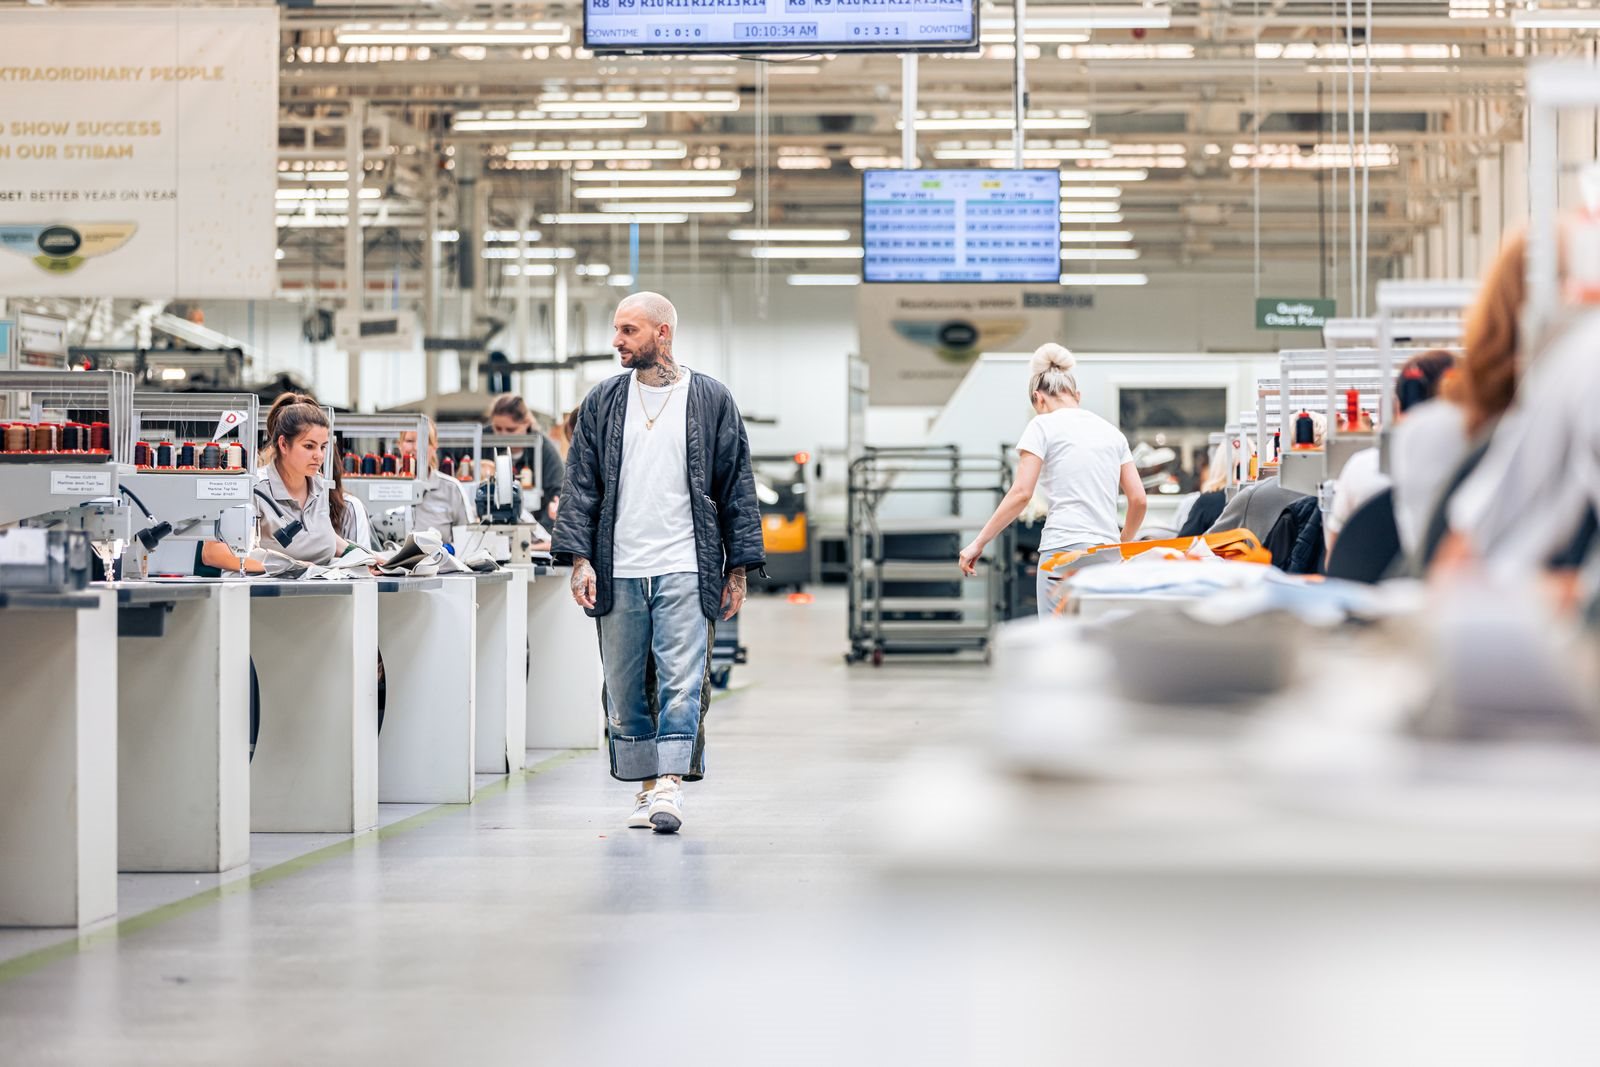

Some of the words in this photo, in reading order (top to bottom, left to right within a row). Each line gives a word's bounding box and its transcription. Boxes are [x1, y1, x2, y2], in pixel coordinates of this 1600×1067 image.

[587, 29, 639, 37] DOWNTIME
[744, 25, 796, 38] 10:10:34
[799, 25, 817, 37] AM
[919, 24, 970, 34] DOWNTIME
[150, 66, 225, 82] PEOPLE
[10, 121, 70, 137] SHOW
[76, 120, 161, 137] SUCCESS
[16, 144, 57, 160] OUR
[30, 190, 80, 200] BETTER
[84, 190, 117, 200] YEAR
[144, 190, 178, 200] YEAR
[1276, 302, 1315, 316] Quality
[1264, 312, 1297, 326] Check
